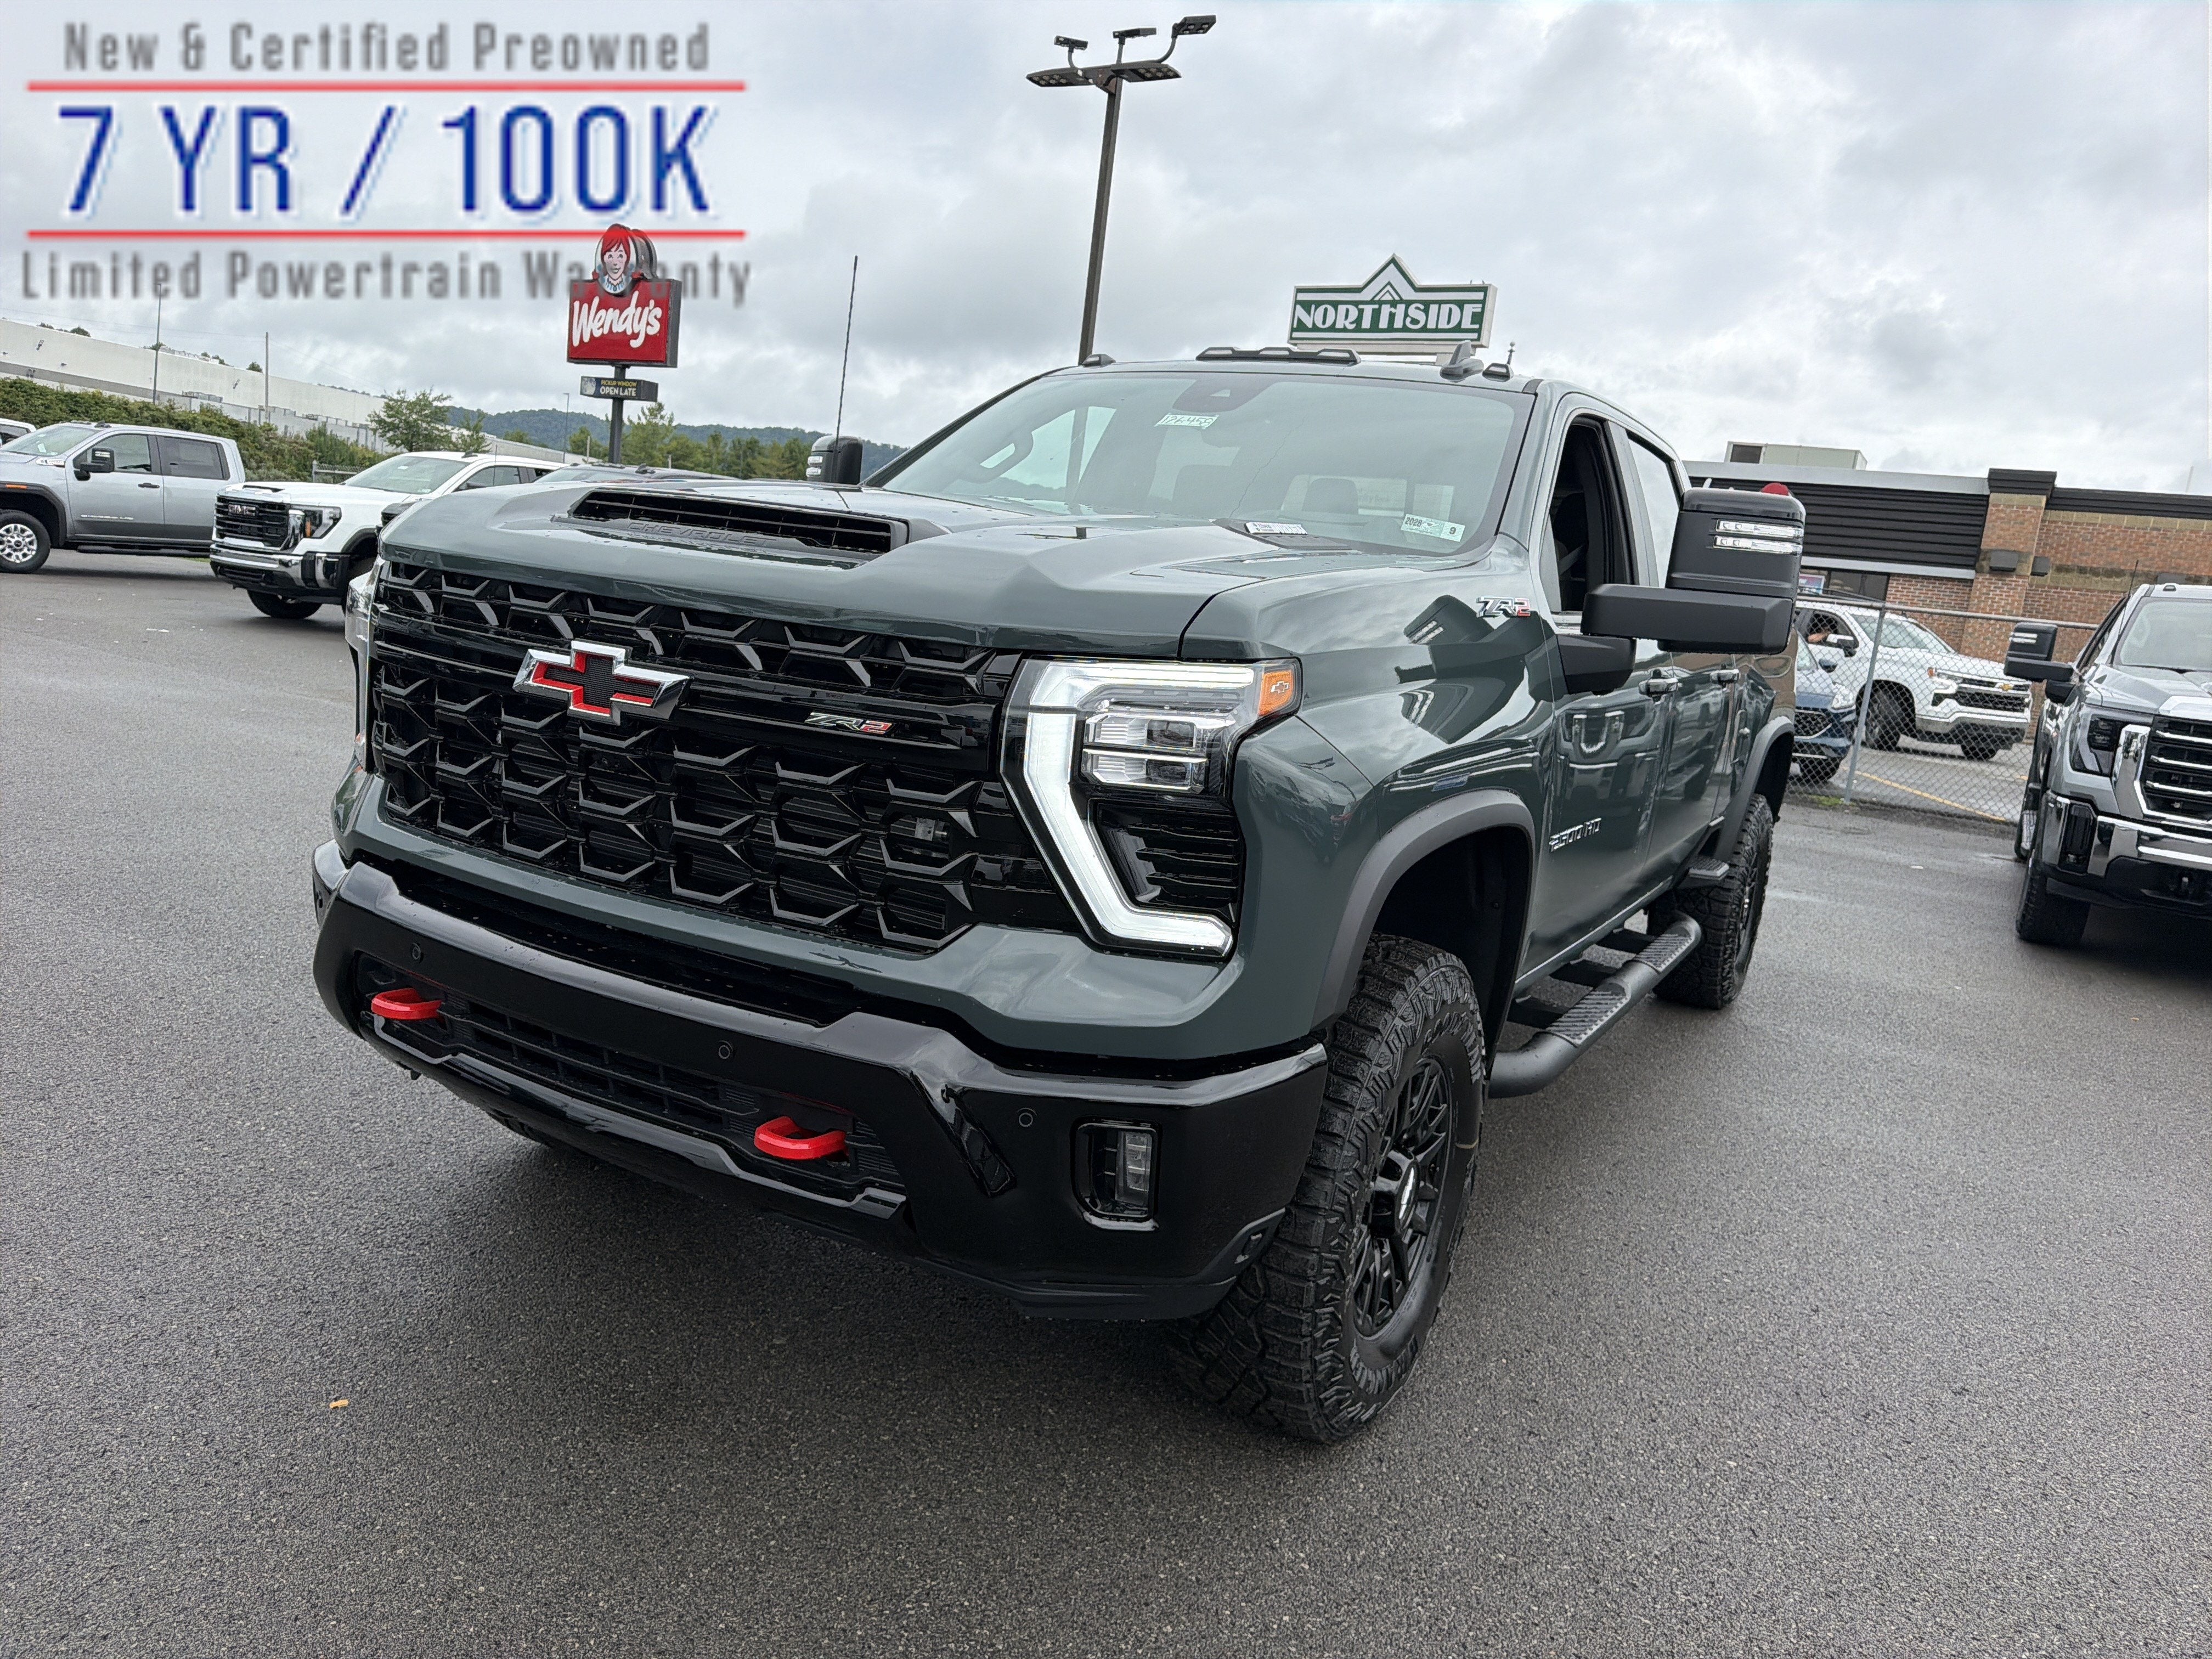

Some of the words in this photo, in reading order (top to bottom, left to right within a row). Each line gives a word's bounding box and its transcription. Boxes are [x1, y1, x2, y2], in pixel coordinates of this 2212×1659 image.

[572, 290, 662, 348] Wendy's
[1293, 303, 1482, 330] NORTHSIDE
[600, 386, 619, 394] OPEN
[620, 387, 636, 396] LATE
[628, 522, 777, 546] CHEVROLET
[1405, 517, 1423, 527] 2028
[1449, 527, 1457, 535] 9
